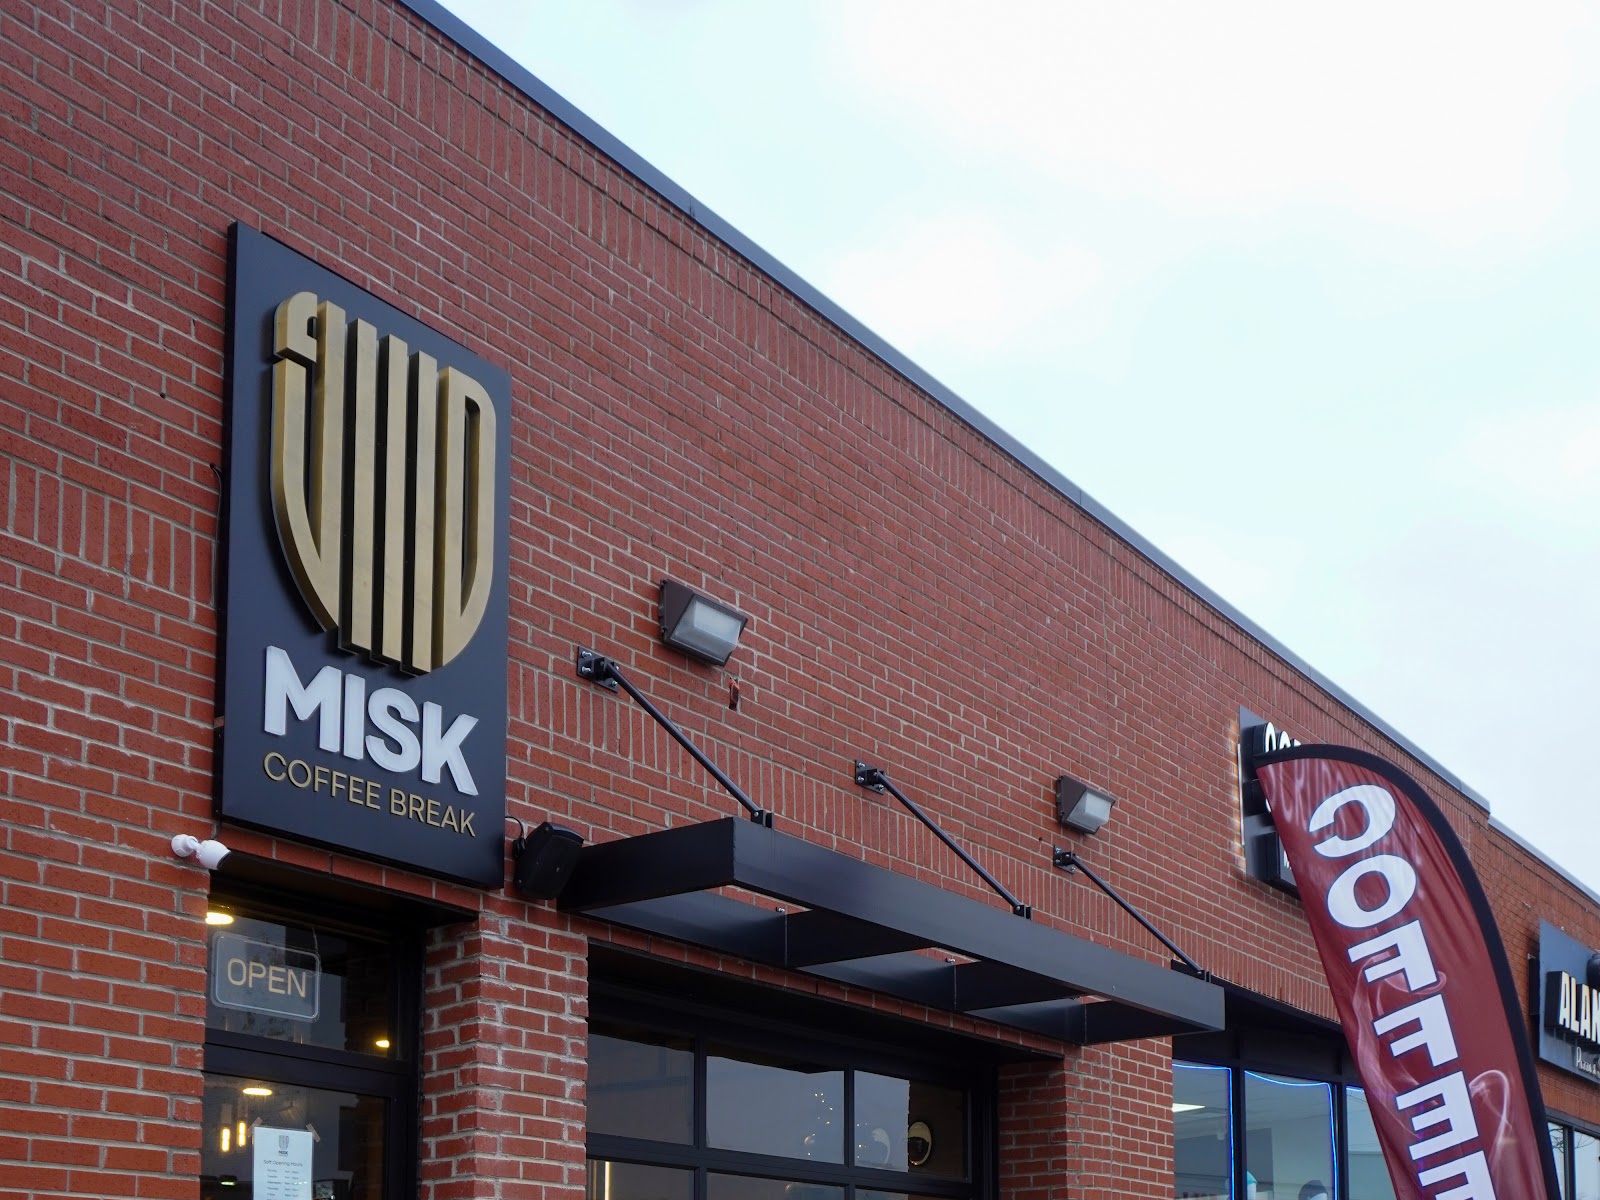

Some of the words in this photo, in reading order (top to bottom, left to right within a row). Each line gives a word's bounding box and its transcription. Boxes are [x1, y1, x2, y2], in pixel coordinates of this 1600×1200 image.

[264, 645, 479, 796] MISK
[263, 751, 381, 810] COFFEE
[390, 788, 476, 838] BREAK
[227, 957, 306, 999] OPEN
